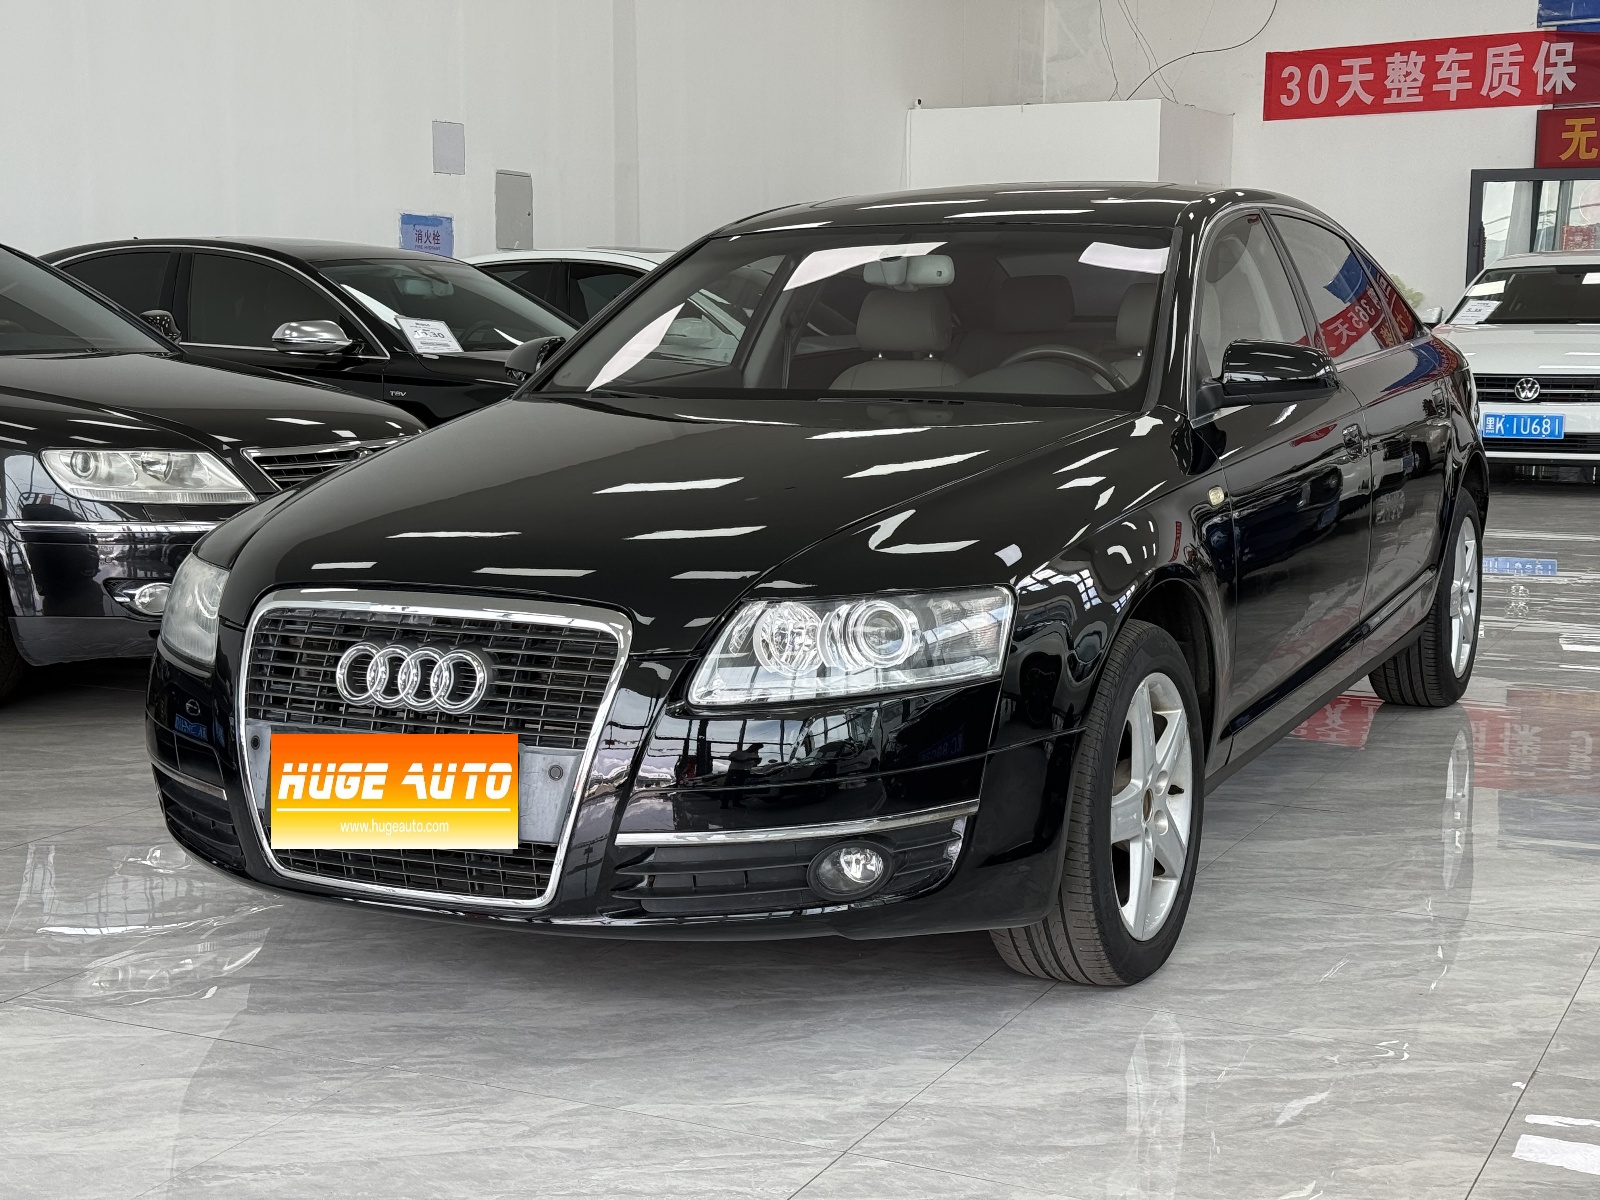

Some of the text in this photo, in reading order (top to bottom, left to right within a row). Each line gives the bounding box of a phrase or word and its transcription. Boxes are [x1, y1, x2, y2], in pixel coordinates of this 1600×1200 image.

[1280, 41, 1577, 108] 30天整车质保
[1559, 117, 1599, 161] 无
[415, 229, 441, 245] 消火栓
